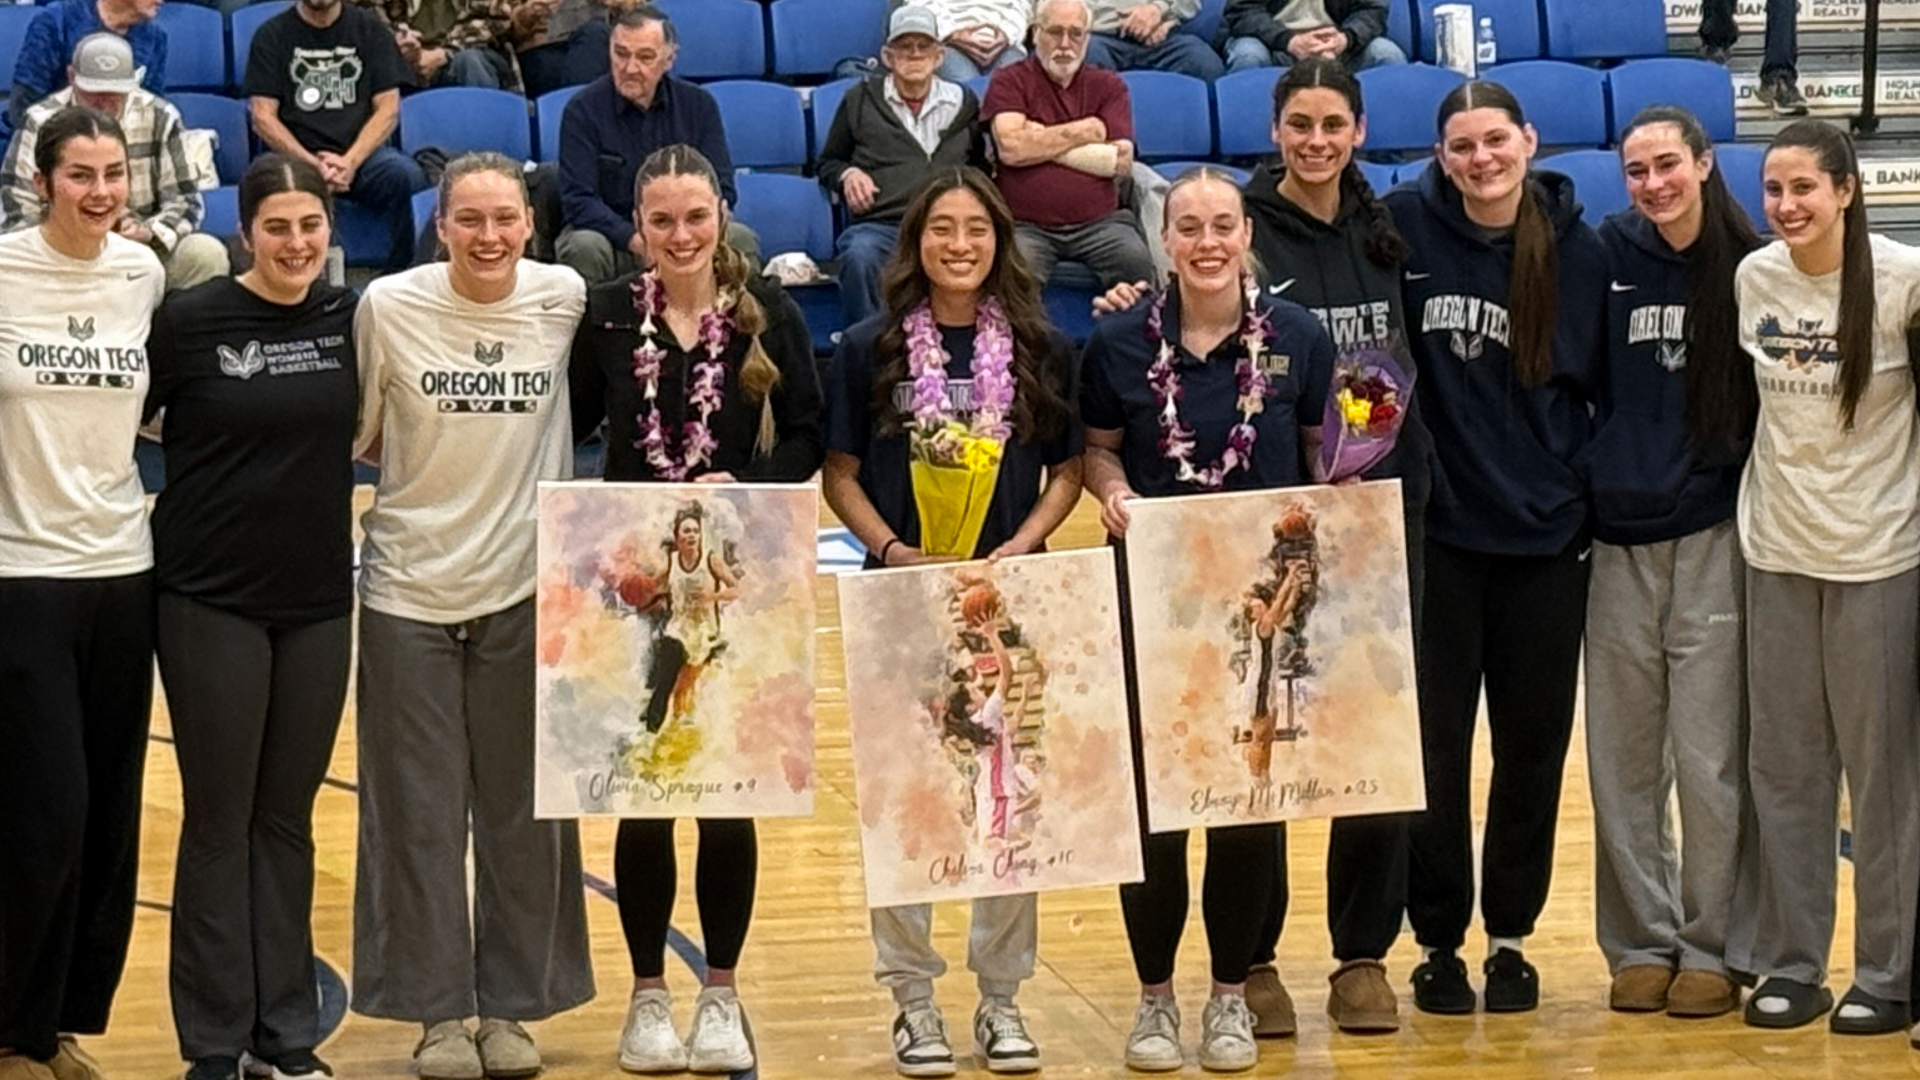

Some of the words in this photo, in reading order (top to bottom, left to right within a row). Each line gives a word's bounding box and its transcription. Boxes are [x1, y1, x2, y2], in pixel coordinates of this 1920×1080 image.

[1804, 84, 1863, 99] BANKE
[1876, 168, 1920, 185] BANK
[1422, 294, 1481, 333] OREGON
[1481, 300, 1511, 348] TEC
[263, 340, 315, 354] OREGON
[317, 335, 345, 348] TECH
[18, 343, 101, 370] OREGON
[104, 346, 146, 373] TECH
[269, 357, 342, 375] BASKETBALL
[39, 372, 133, 388] OWLS
[421, 371, 506, 396] OREGON
[511, 370, 552, 396] TECH
[440, 399, 537, 413] OWLS
